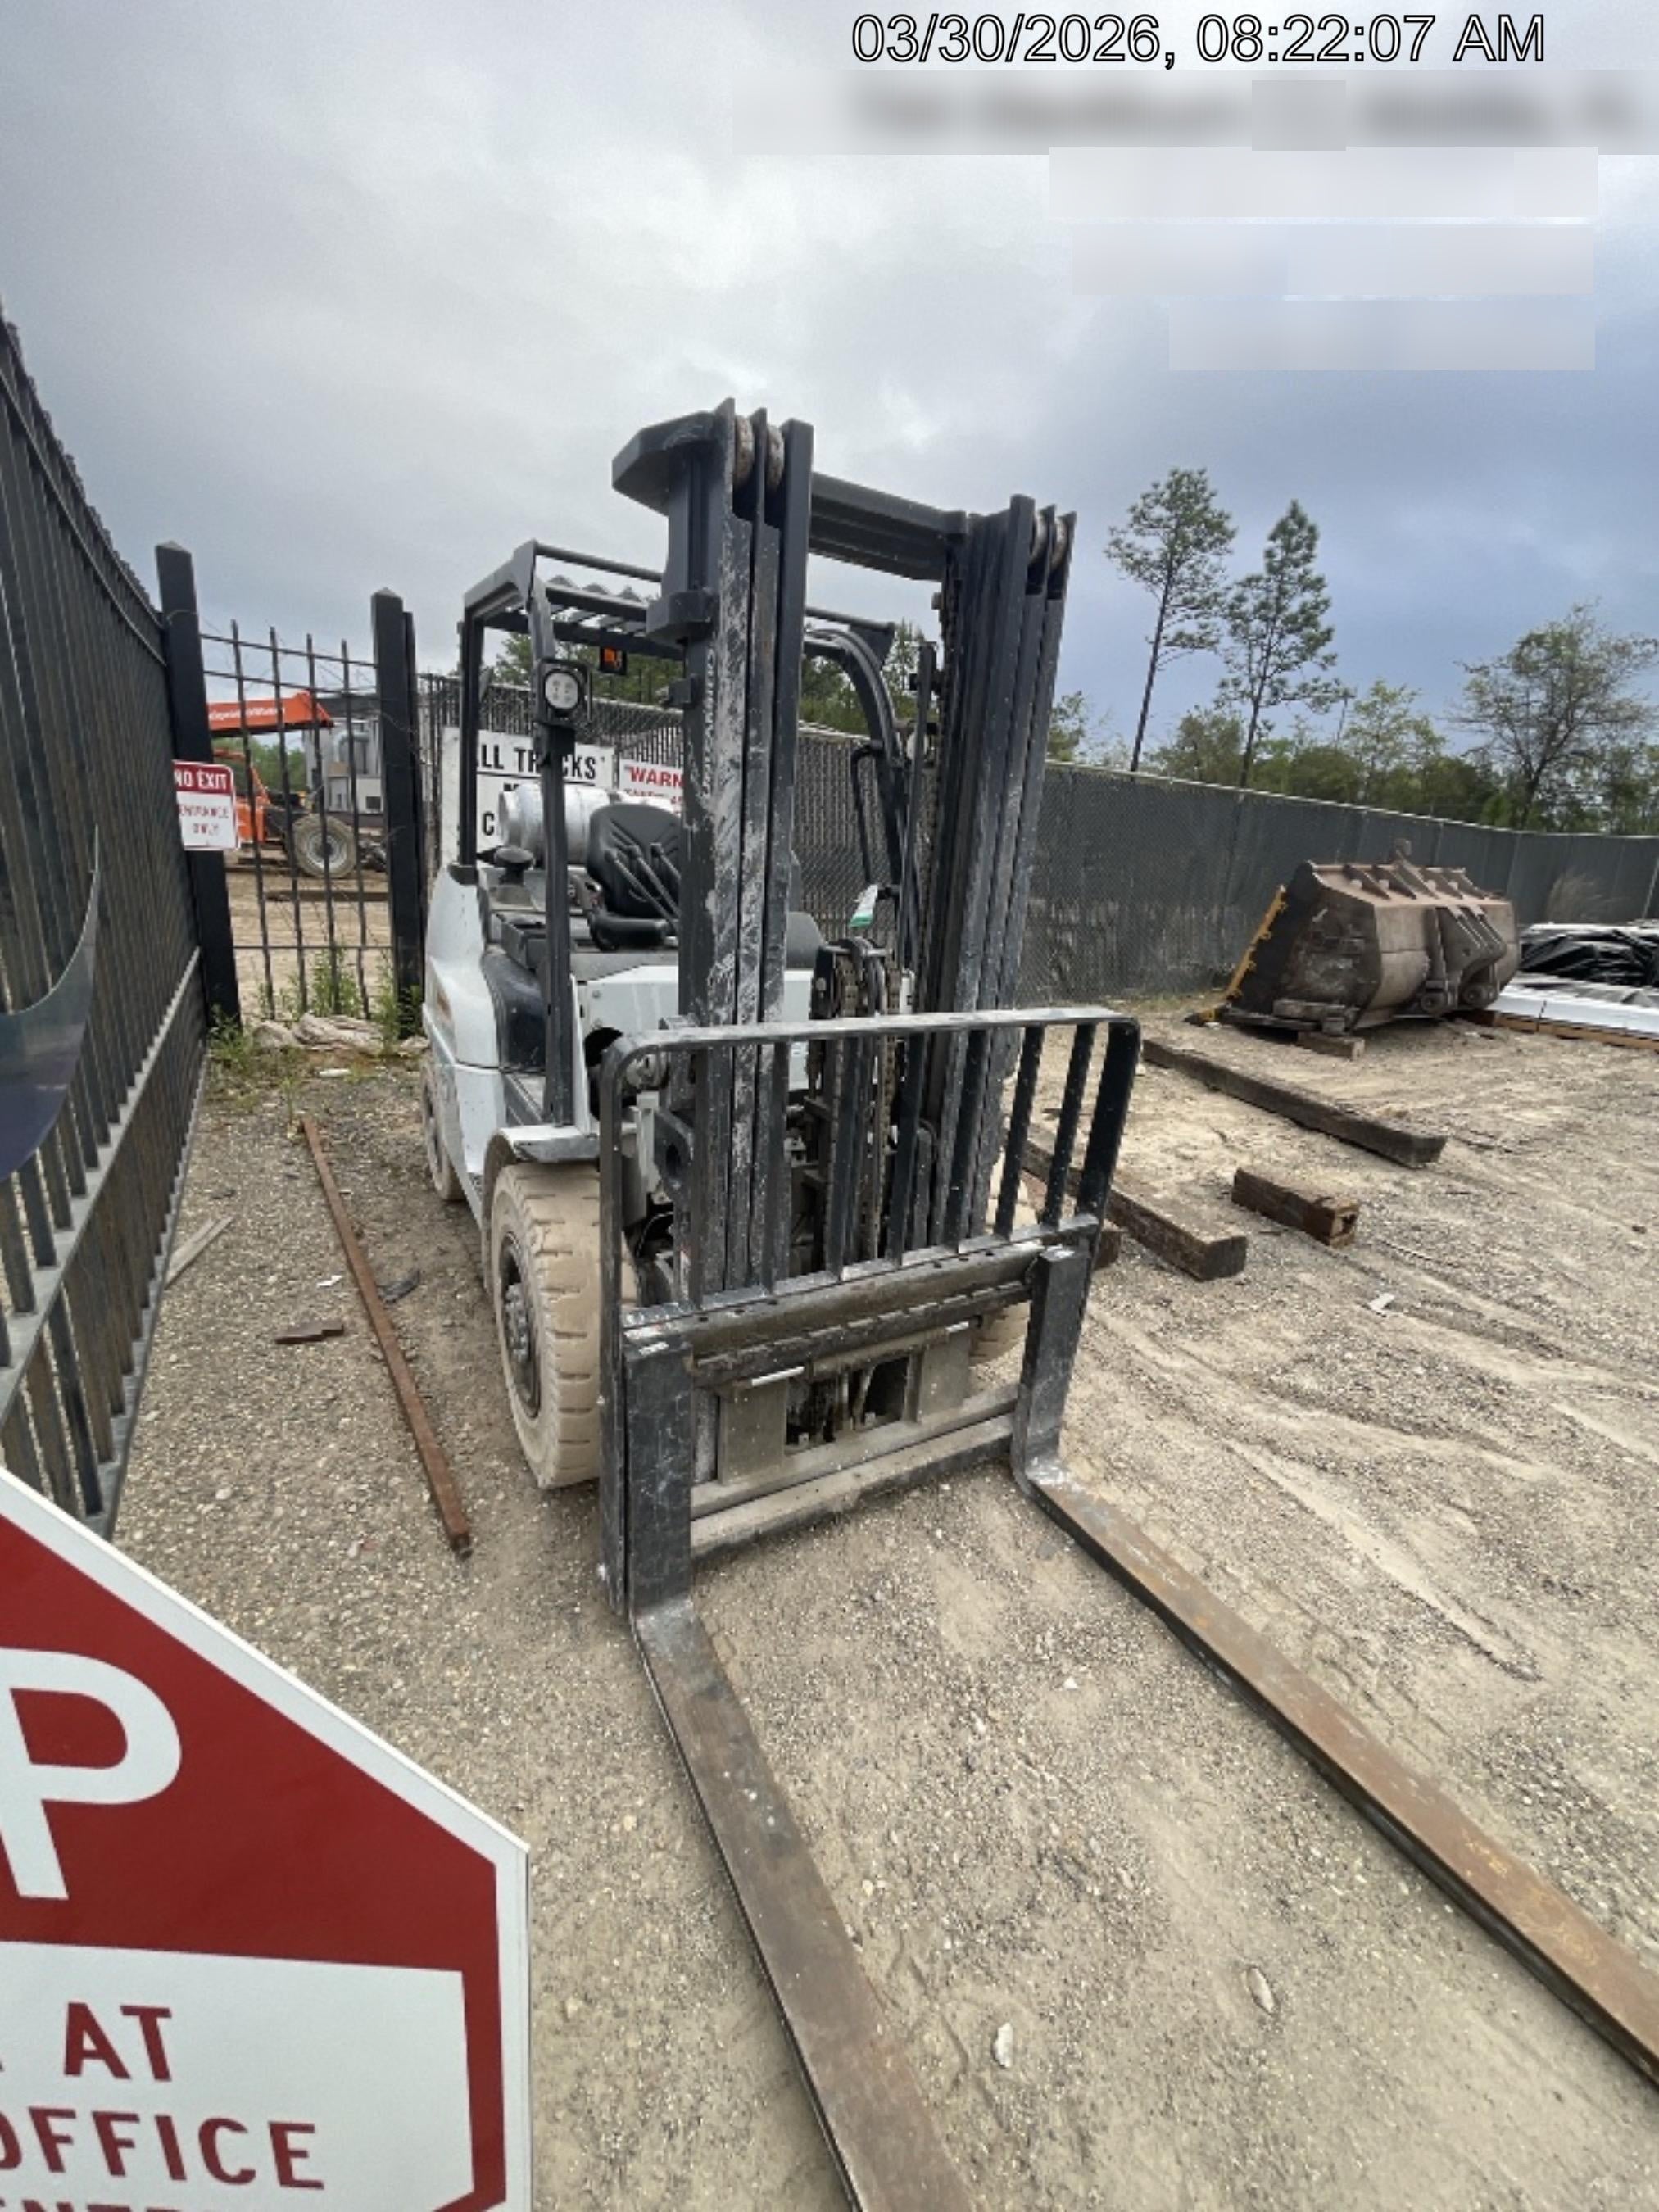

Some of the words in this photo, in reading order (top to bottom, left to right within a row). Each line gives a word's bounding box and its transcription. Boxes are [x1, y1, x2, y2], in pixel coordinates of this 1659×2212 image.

[478, 744, 505, 770] LL
[514, 747, 596, 780] TRCKS
[197, 771, 227, 791] EXIT
[64, 2002, 172, 2082] AT
